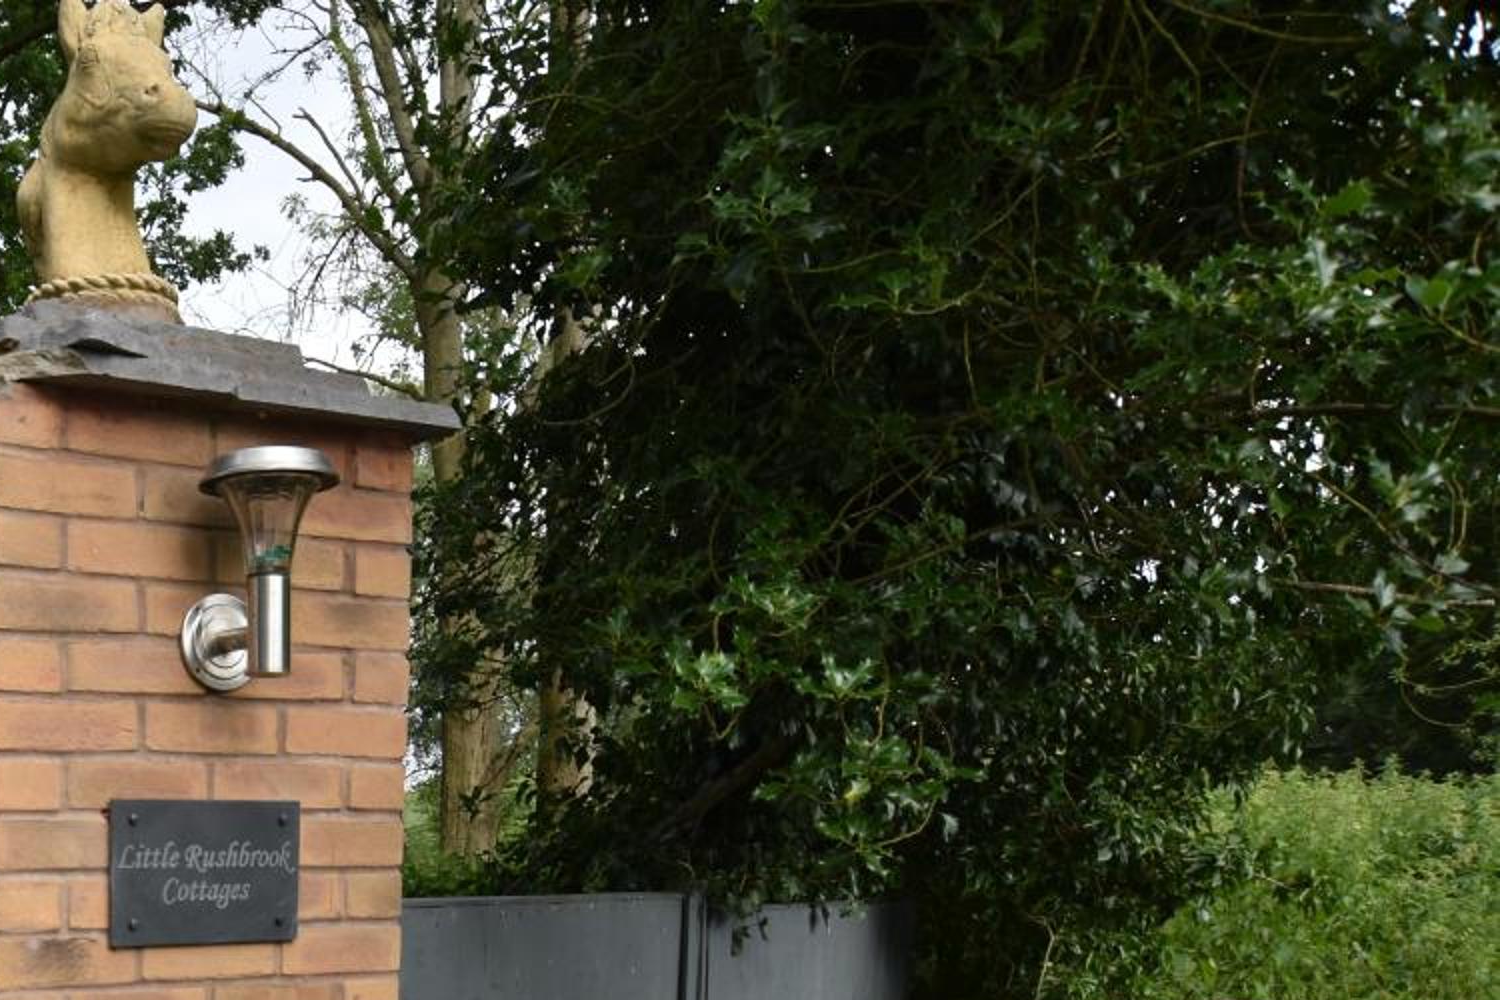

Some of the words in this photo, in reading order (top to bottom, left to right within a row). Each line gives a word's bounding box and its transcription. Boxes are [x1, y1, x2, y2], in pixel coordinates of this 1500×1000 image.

[118, 841, 180, 869] Little
[184, 840, 296, 873] Rushbrook
[162, 877, 251, 909] Cottages
